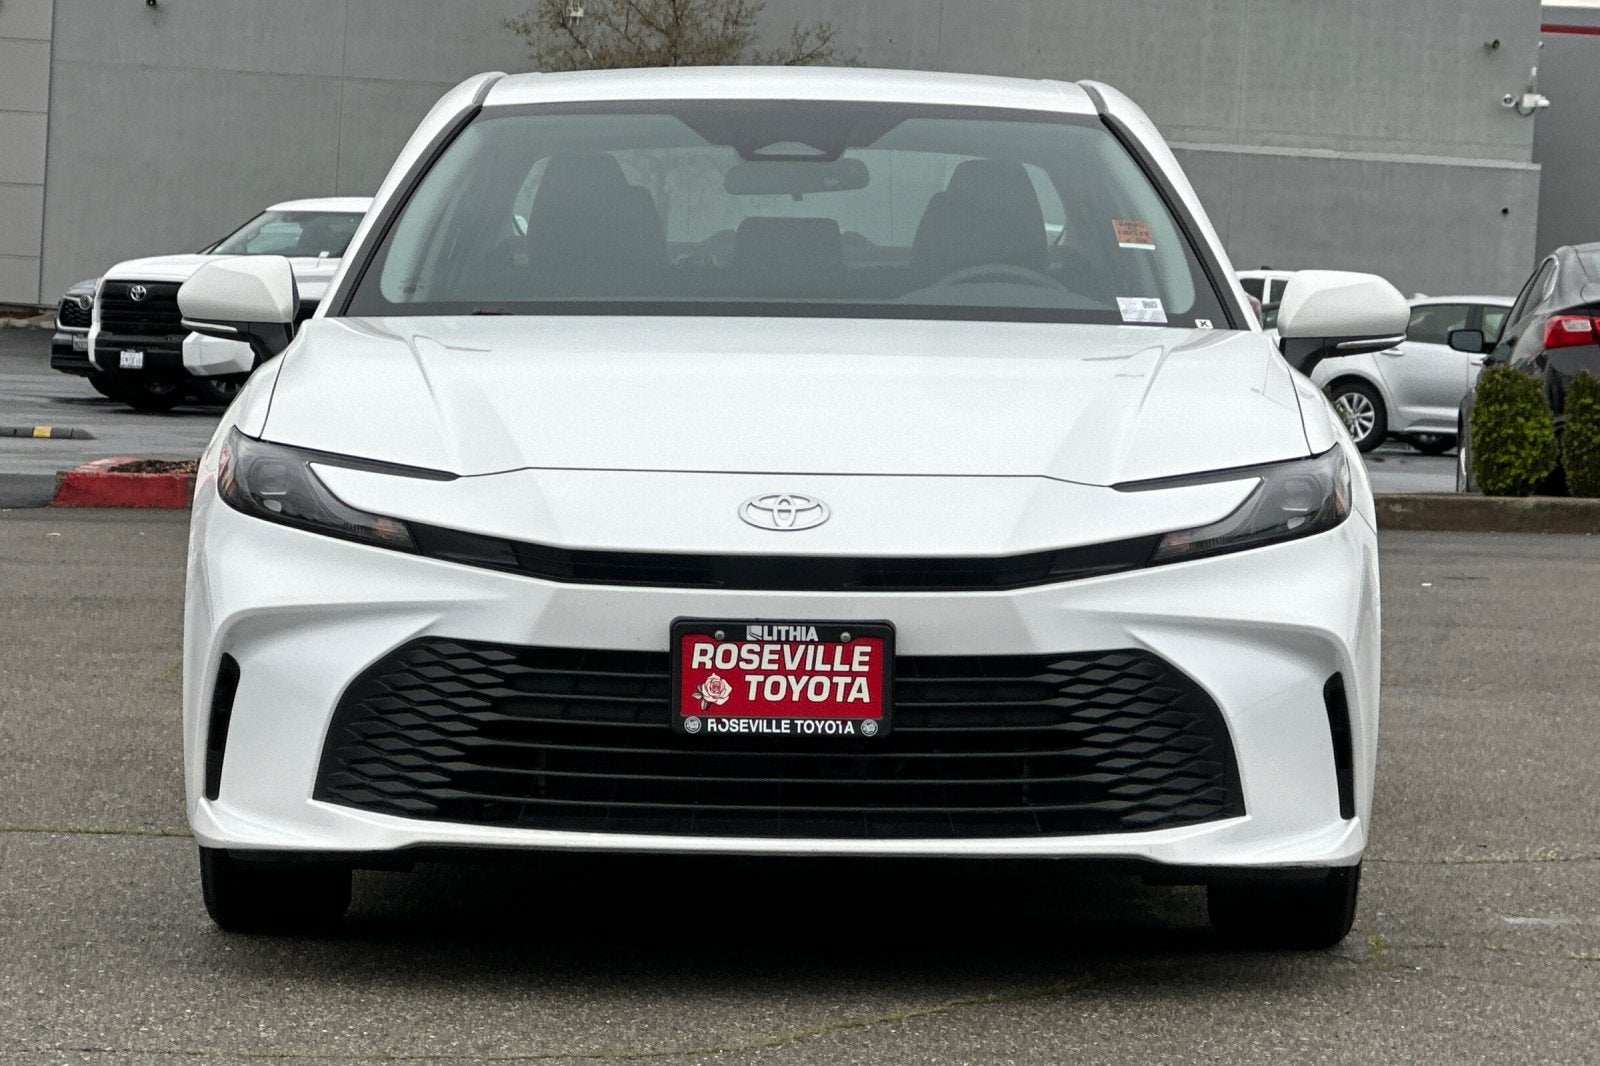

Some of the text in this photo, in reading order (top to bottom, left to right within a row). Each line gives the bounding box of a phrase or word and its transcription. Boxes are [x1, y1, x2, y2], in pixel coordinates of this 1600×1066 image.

[765, 626, 818, 641] LITHIA
[691, 643, 872, 671] ROSEVILLE
[745, 675, 870, 703] TOYOTA
[708, 718, 855, 734] ROSEVILLE TOYOTA
